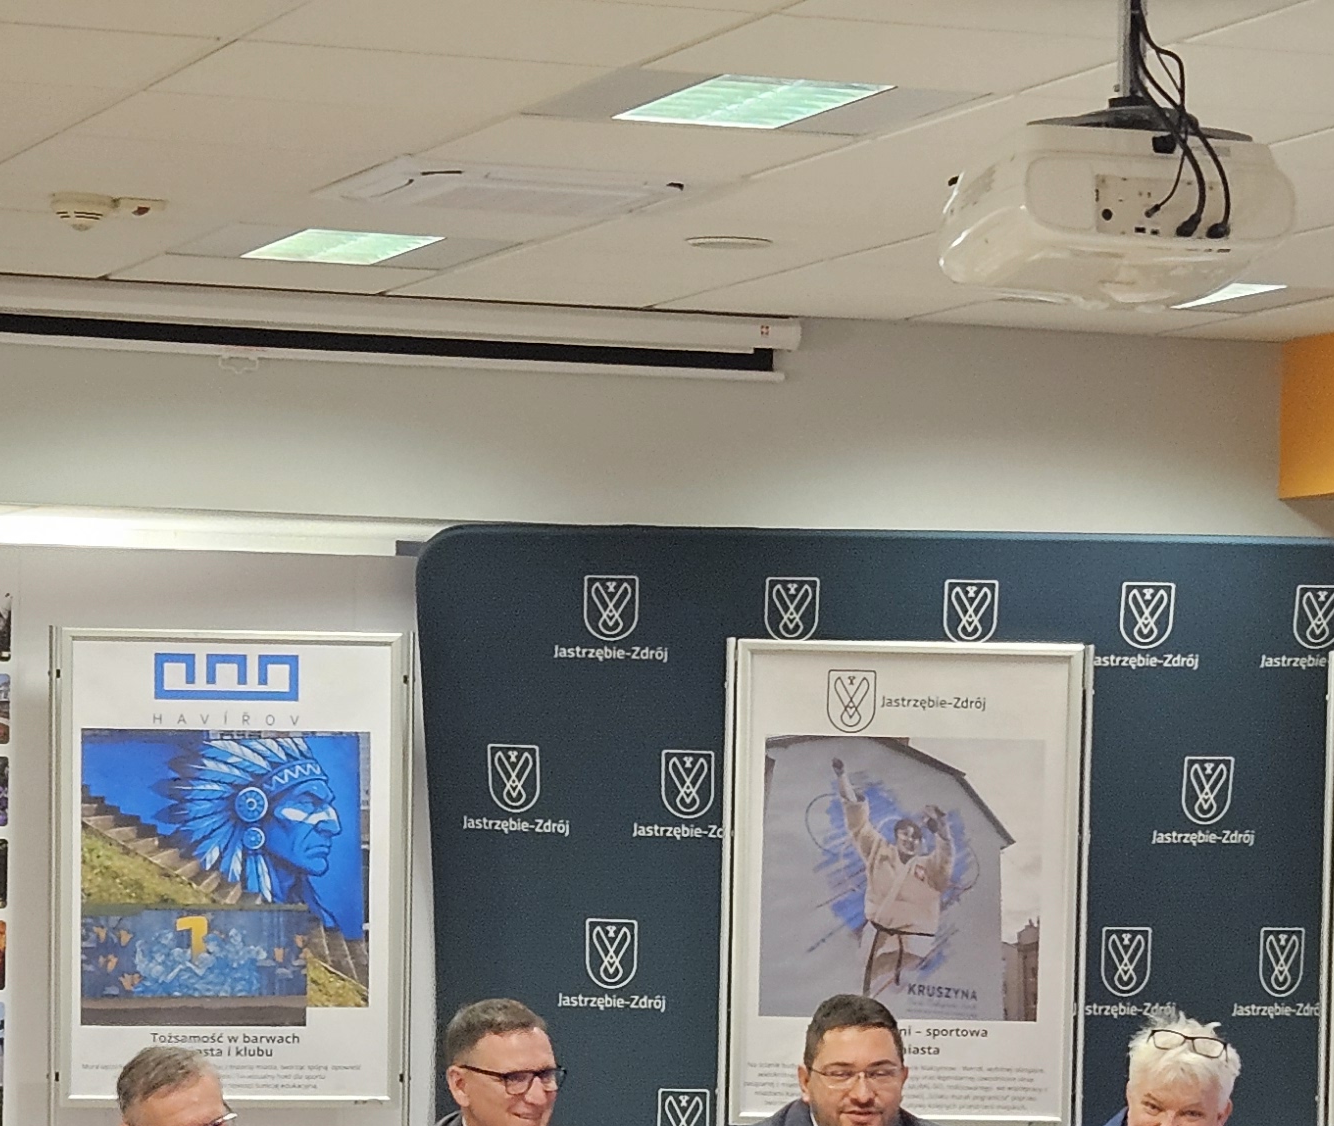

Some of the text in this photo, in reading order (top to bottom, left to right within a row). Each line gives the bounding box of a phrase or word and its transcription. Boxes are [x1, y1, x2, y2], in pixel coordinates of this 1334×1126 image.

[553, 645, 668, 663] Jastrzębie-Zdrój
[1094, 653, 1199, 670] astrzębie-Zdrój
[1259, 653, 1327, 671] Jastrzębie
[880, 695, 987, 712] Jastrzębie-Zdrój
[463, 815, 570, 836] Jastrzębie-Zdrój
[632, 822, 725, 840] Jastrzębie-Z
[1152, 829, 1256, 847] Jastrzębie-Zdrój
[907, 983, 978, 1001] KRUSZYNA
[557, 992, 666, 1013] Jastrzębie-Zdrój
[1084, 1002, 1177, 1019] strzębie-Zdrój
[1232, 1003, 1320, 1019] Jastrzębie-Zdró
[227, 1034, 239, 1045] w
[242, 1032, 300, 1045] barwach
[925, 1027, 988, 1039] sportowa
[234, 1045, 274, 1058] klubu
